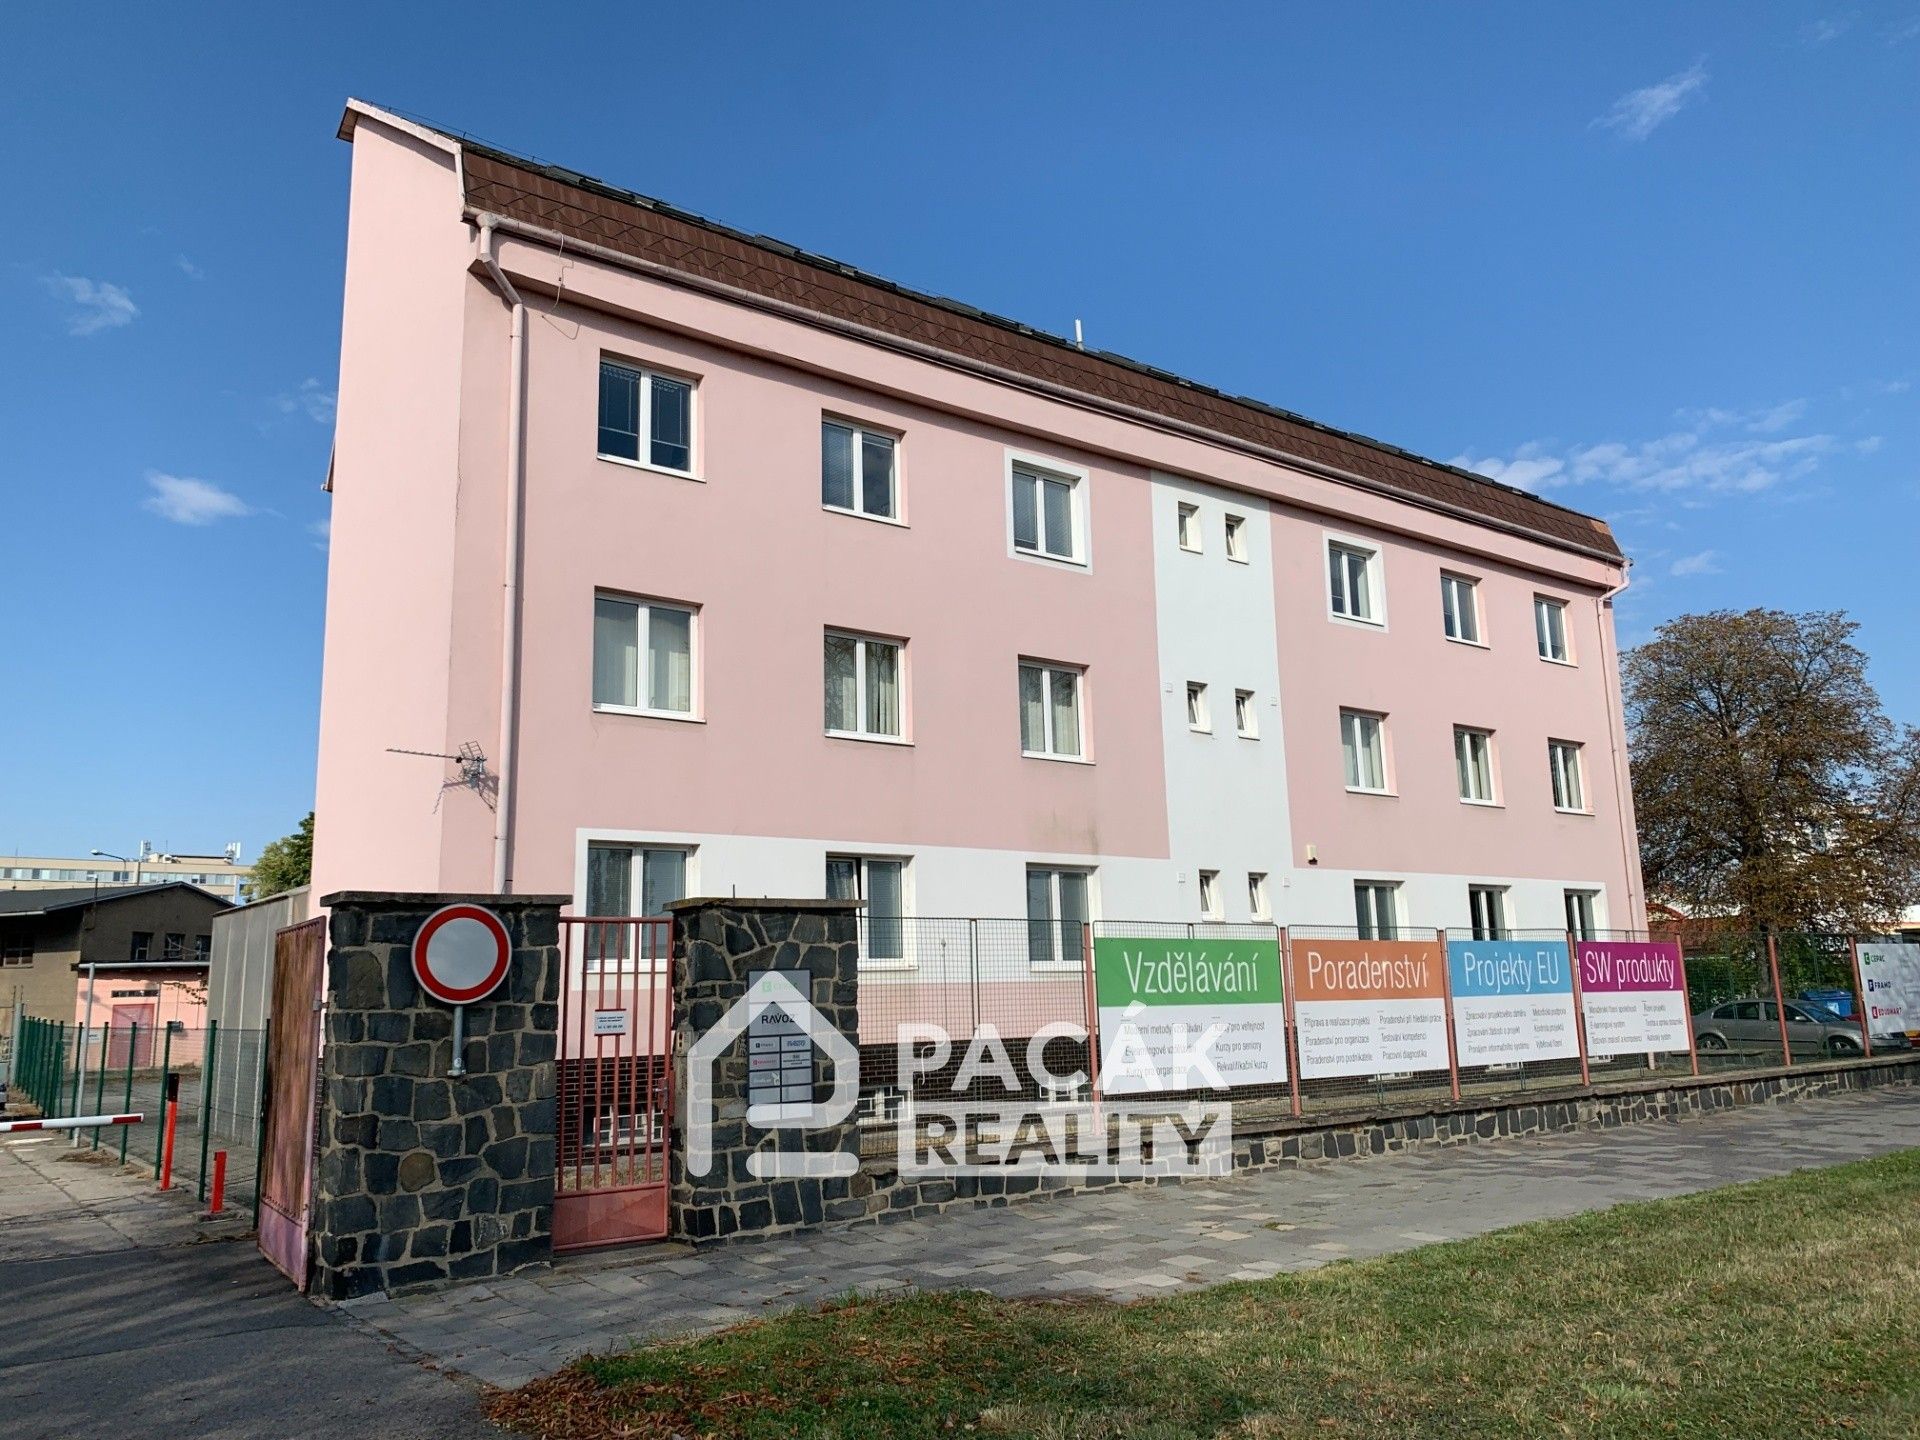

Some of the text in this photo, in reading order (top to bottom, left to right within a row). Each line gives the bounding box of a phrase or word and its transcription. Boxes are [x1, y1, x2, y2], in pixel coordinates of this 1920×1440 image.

[1123, 951, 1259, 993] Vzdělávání
[1307, 951, 1429, 990] Poradenství
[1464, 951, 1559, 993] Projekty EU
[1585, 950, 1674, 989] SW produkty
[1215, 1041, 1262, 1054] Kurzy pro seniory
